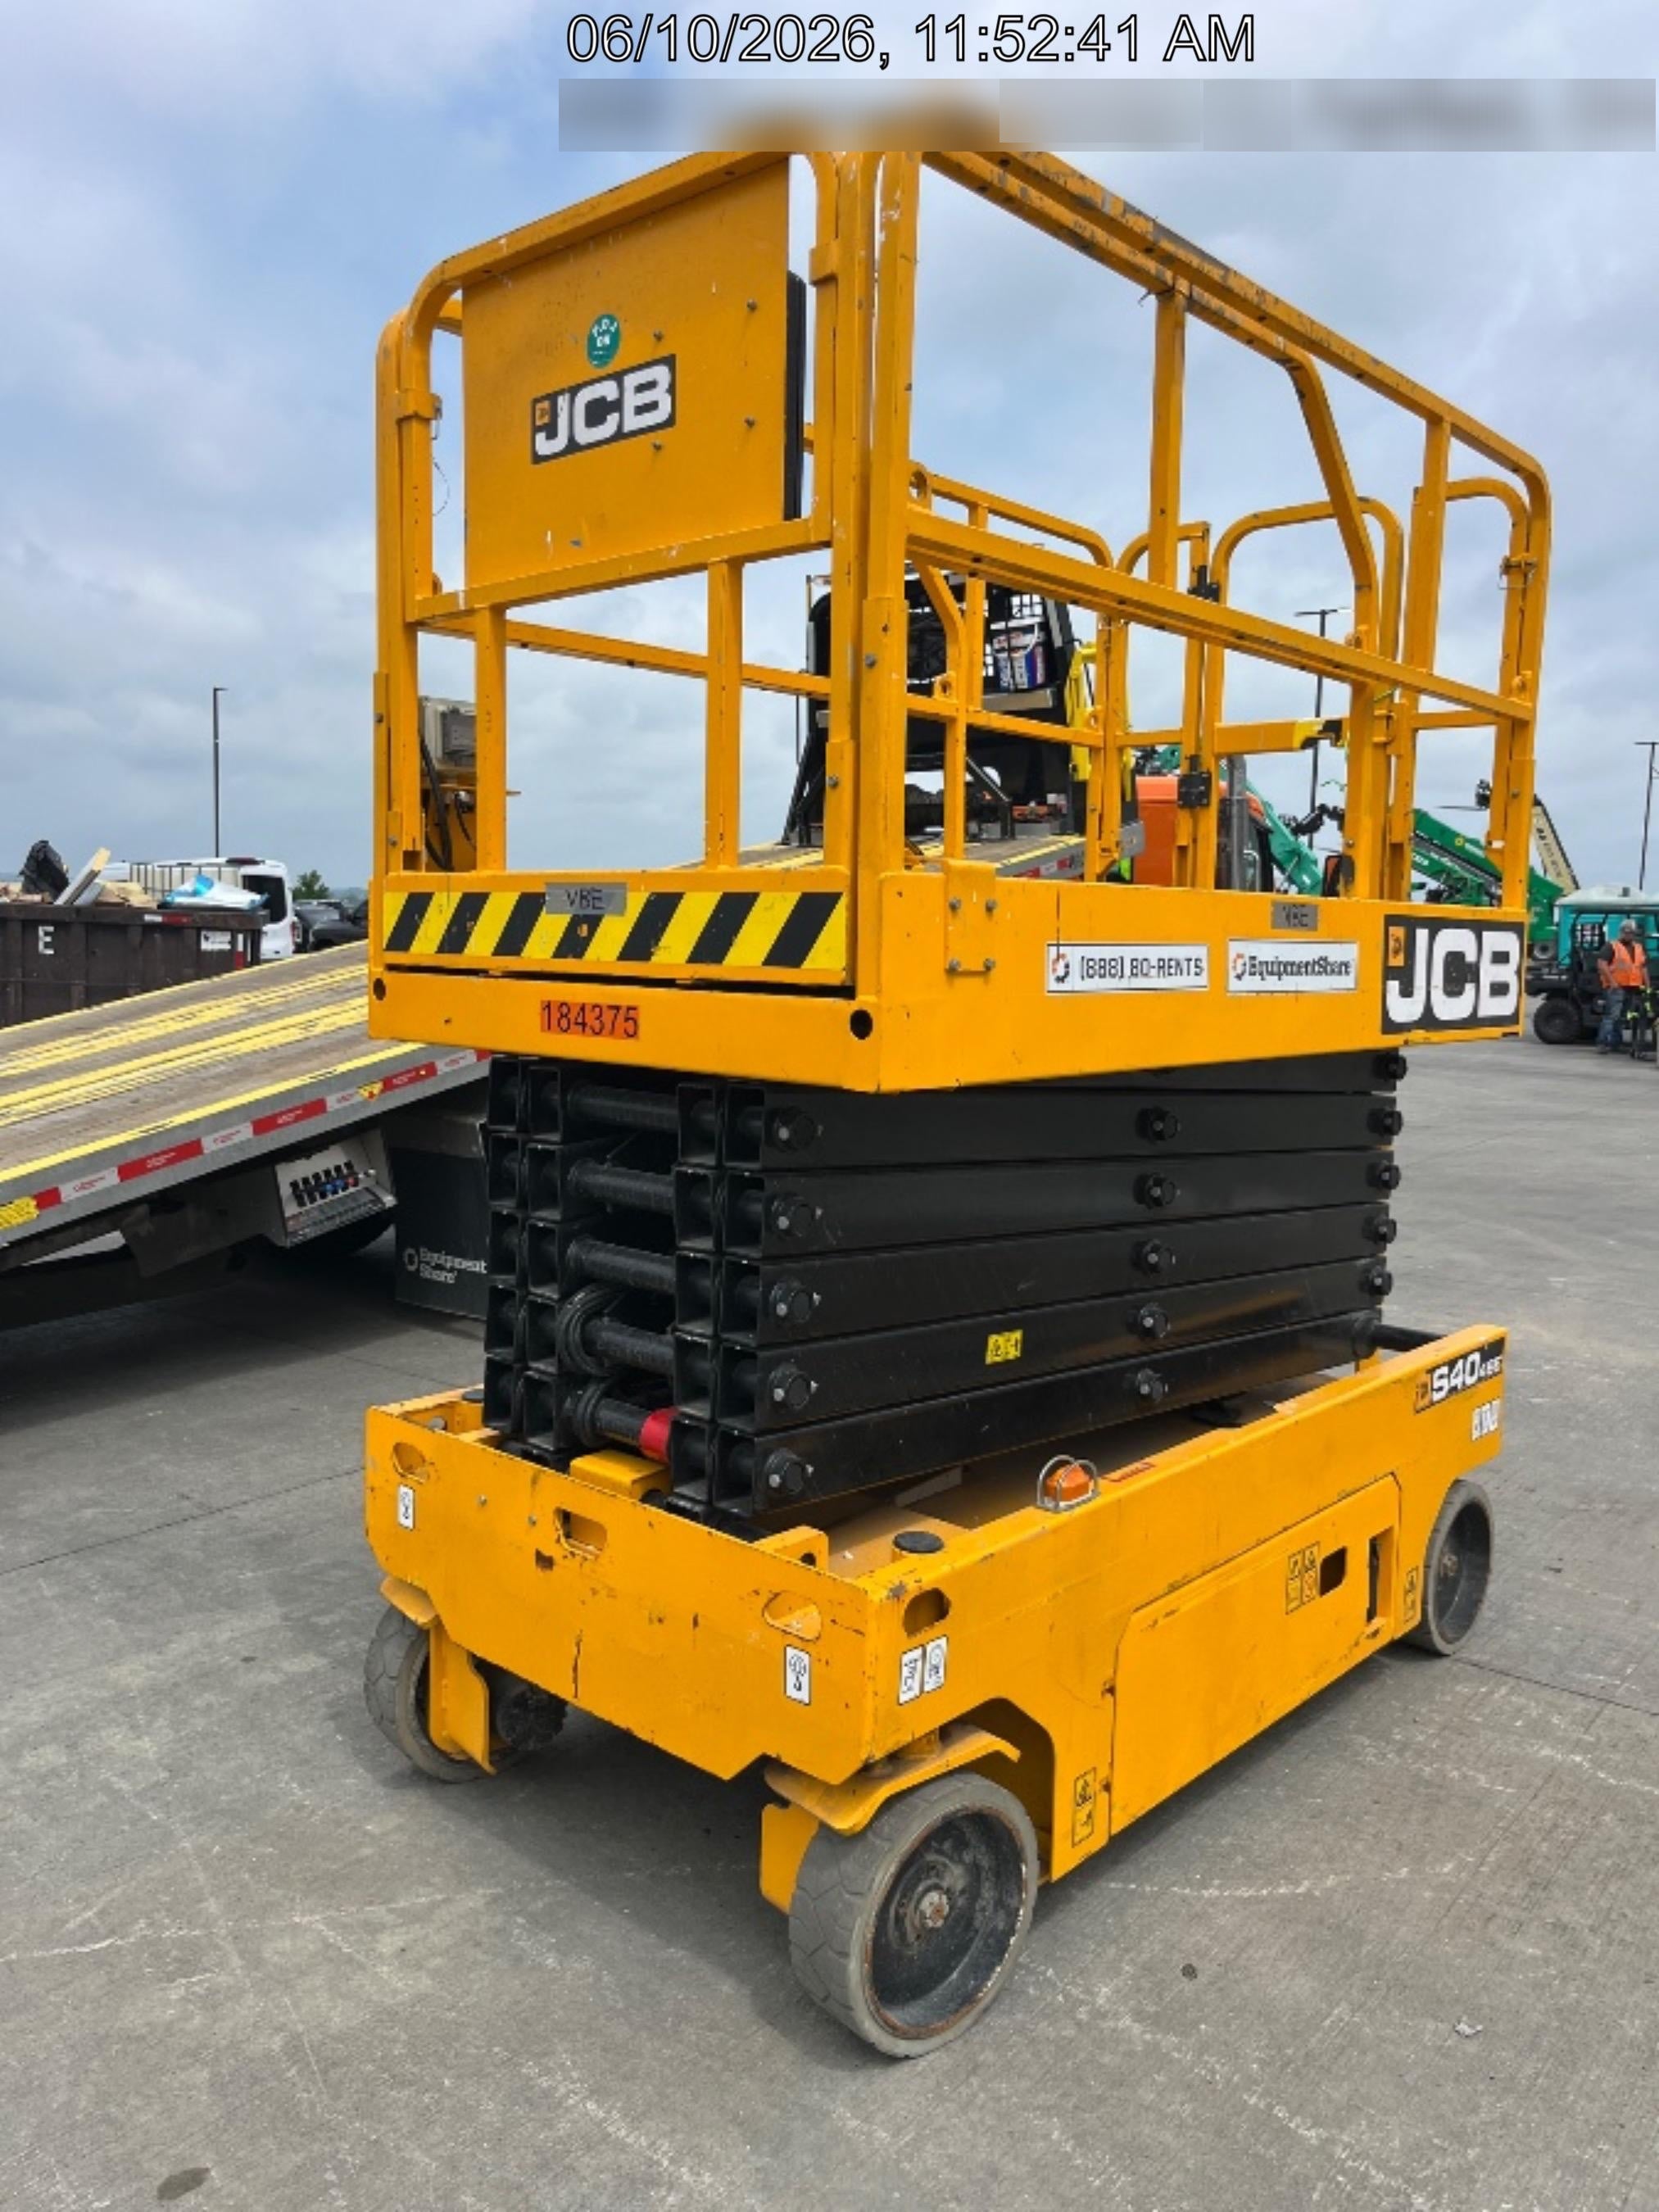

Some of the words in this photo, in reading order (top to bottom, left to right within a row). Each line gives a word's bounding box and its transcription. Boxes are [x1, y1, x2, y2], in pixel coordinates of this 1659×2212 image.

[534, 364, 673, 456] JCB
[564, 887, 605, 910] VBE
[38, 926, 55, 955] E
[1249, 955, 1351, 981] EquipmentShare
[1385, 927, 1521, 1024] JCB
[542, 1000, 638, 1038] 184375
